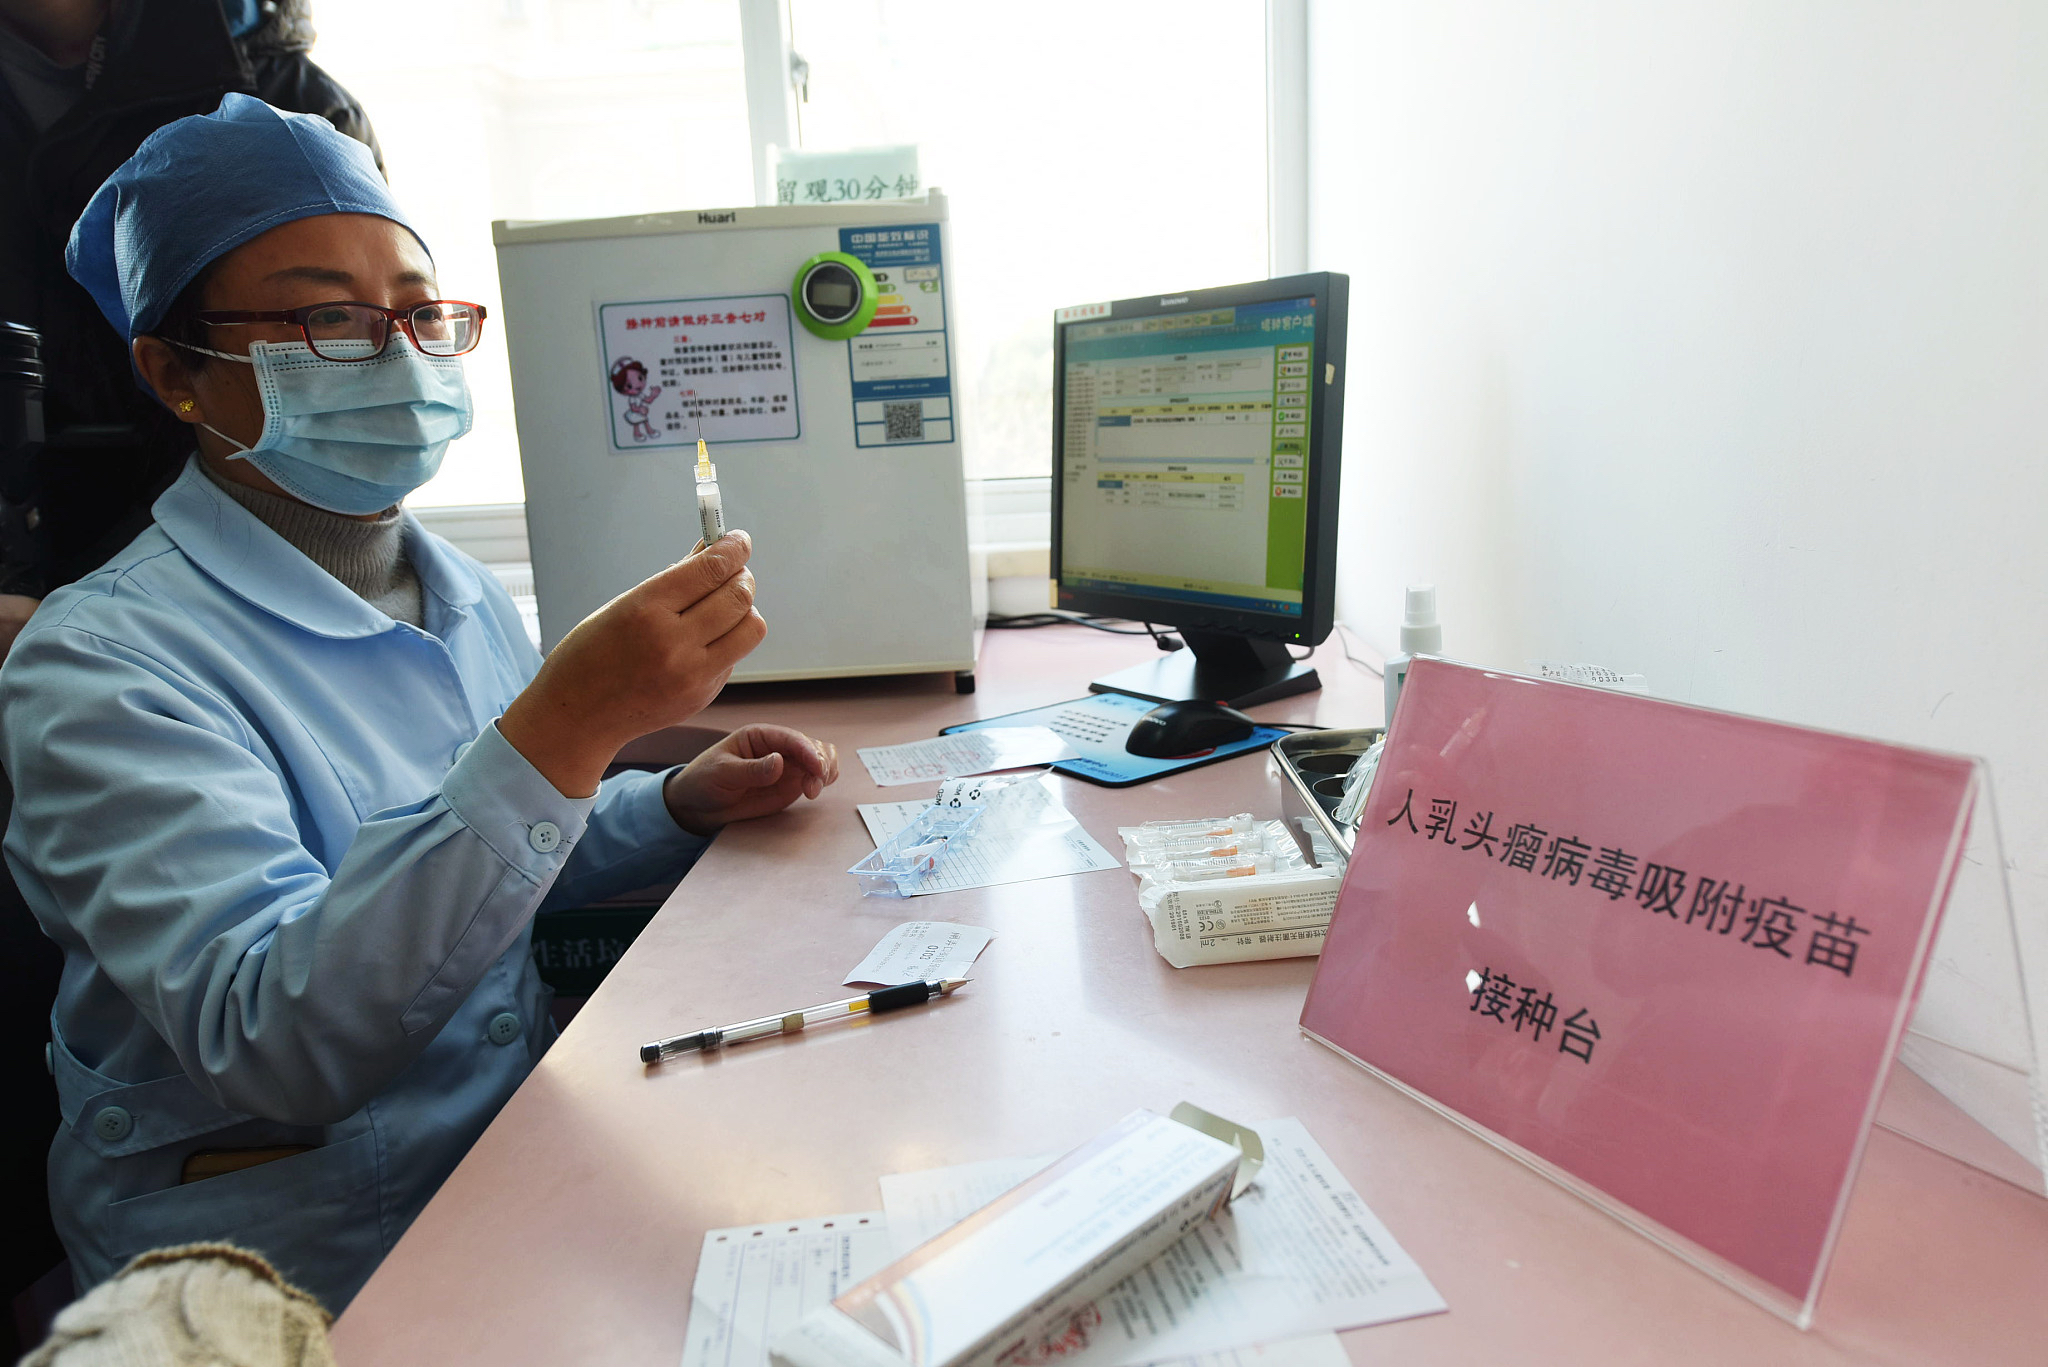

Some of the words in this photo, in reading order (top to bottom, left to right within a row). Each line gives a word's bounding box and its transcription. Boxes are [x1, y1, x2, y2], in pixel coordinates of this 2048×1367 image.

[776, 173, 918, 204] 留观30分钟
[1386, 786, 1874, 979] 人乳头瘤病毒吸附疫苗
[1468, 965, 1604, 1066] 接种台
